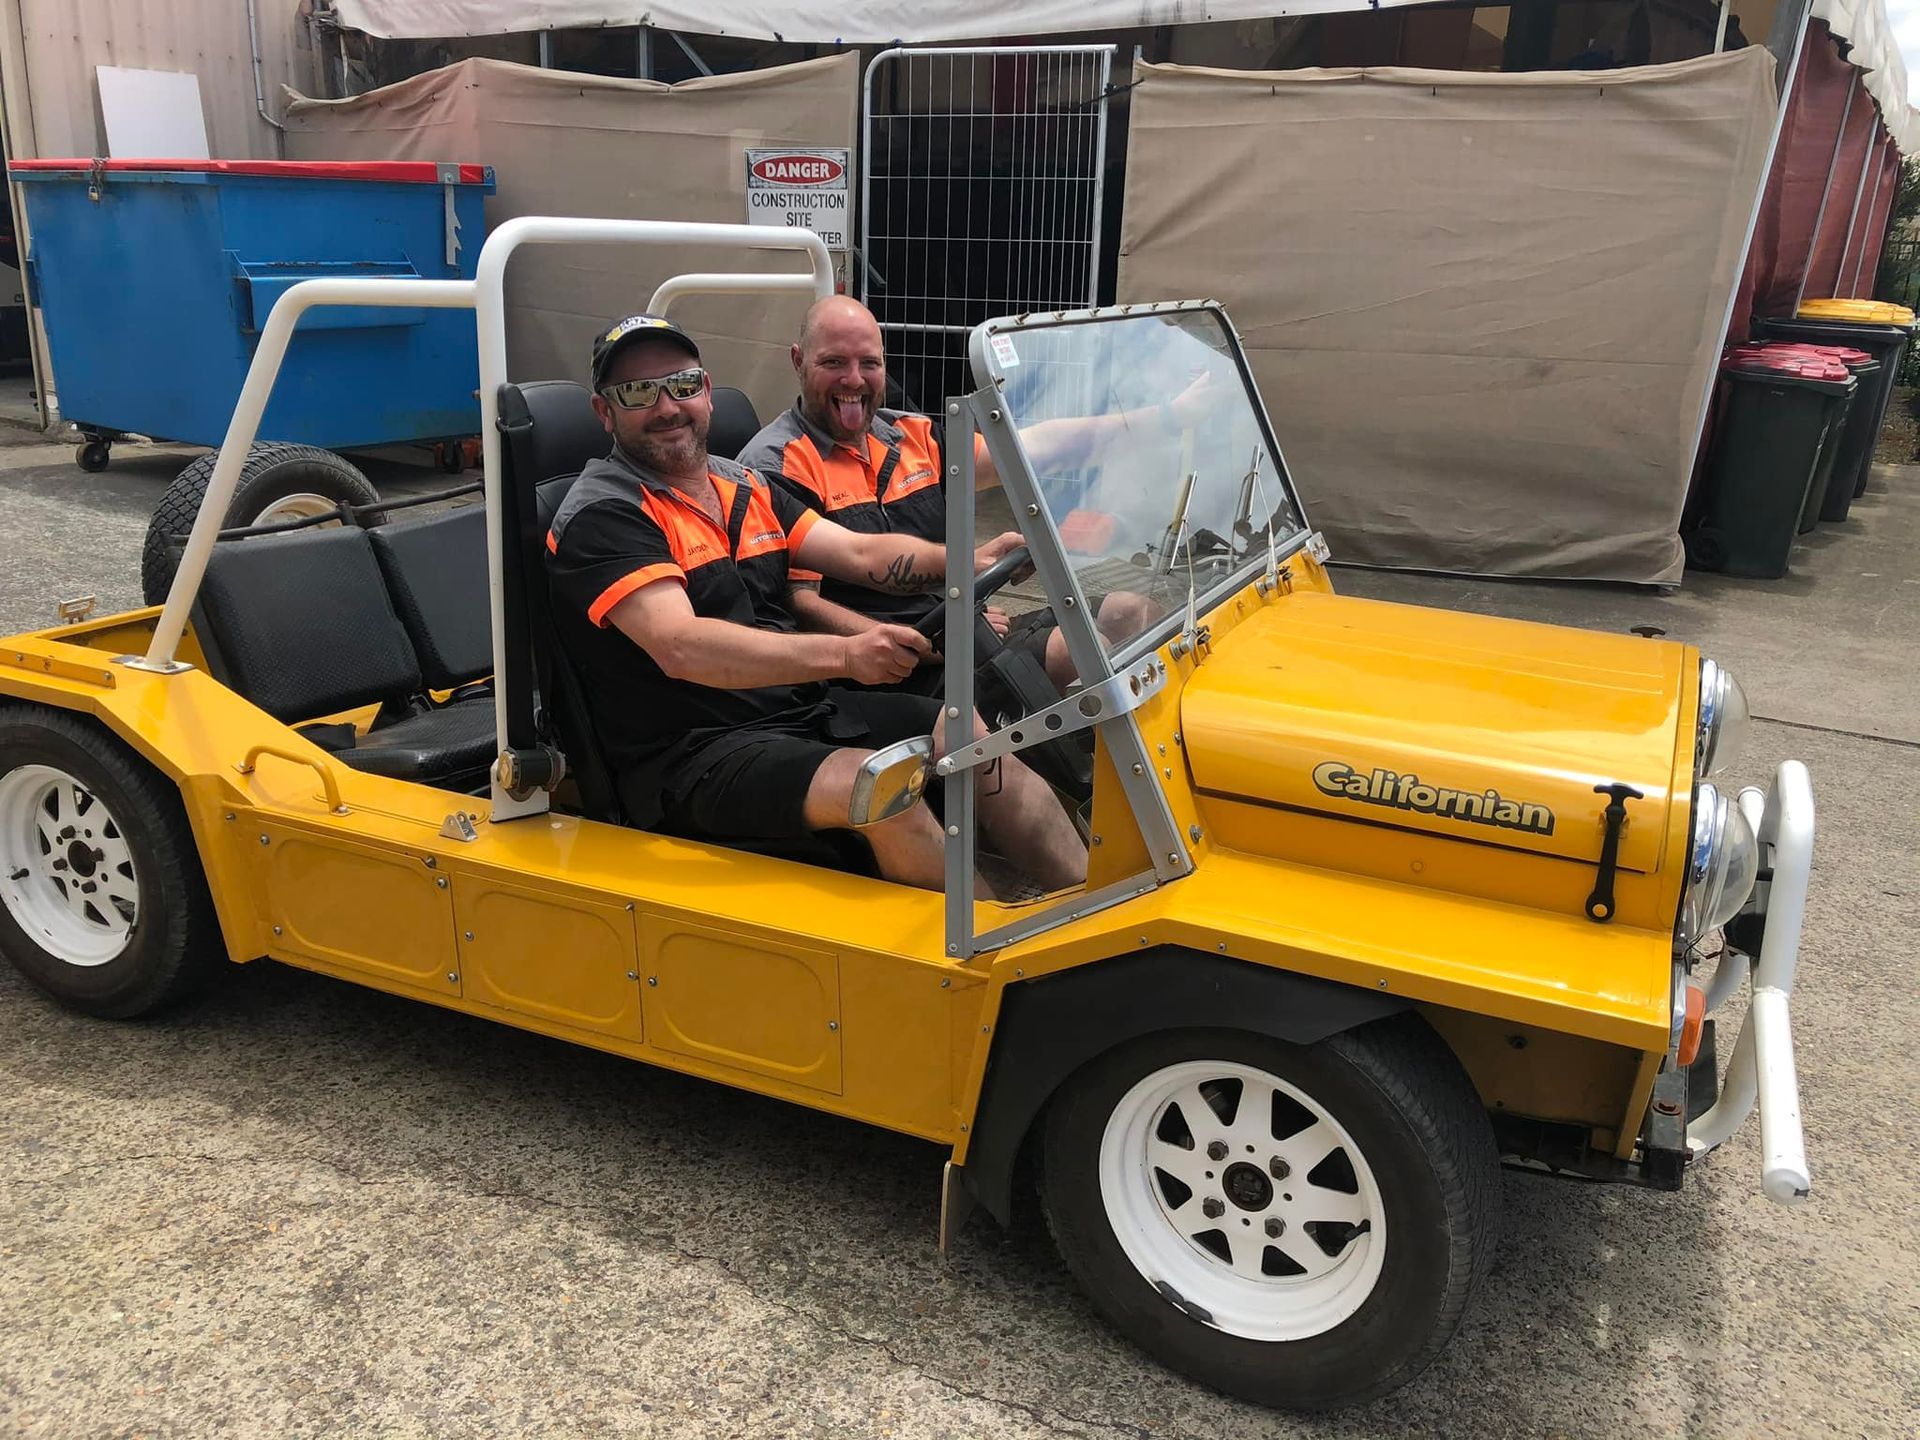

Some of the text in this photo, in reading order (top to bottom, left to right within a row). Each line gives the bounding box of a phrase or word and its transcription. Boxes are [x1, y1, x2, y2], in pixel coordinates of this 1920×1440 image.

[765, 162, 831, 178] DANGER
[751, 193, 845, 209] CONSTRUCTION
[786, 212, 812, 227] SITE
[817, 231, 842, 245] TER
[832, 490, 850, 502] NEAL
[1312, 761, 1555, 837] Californian
